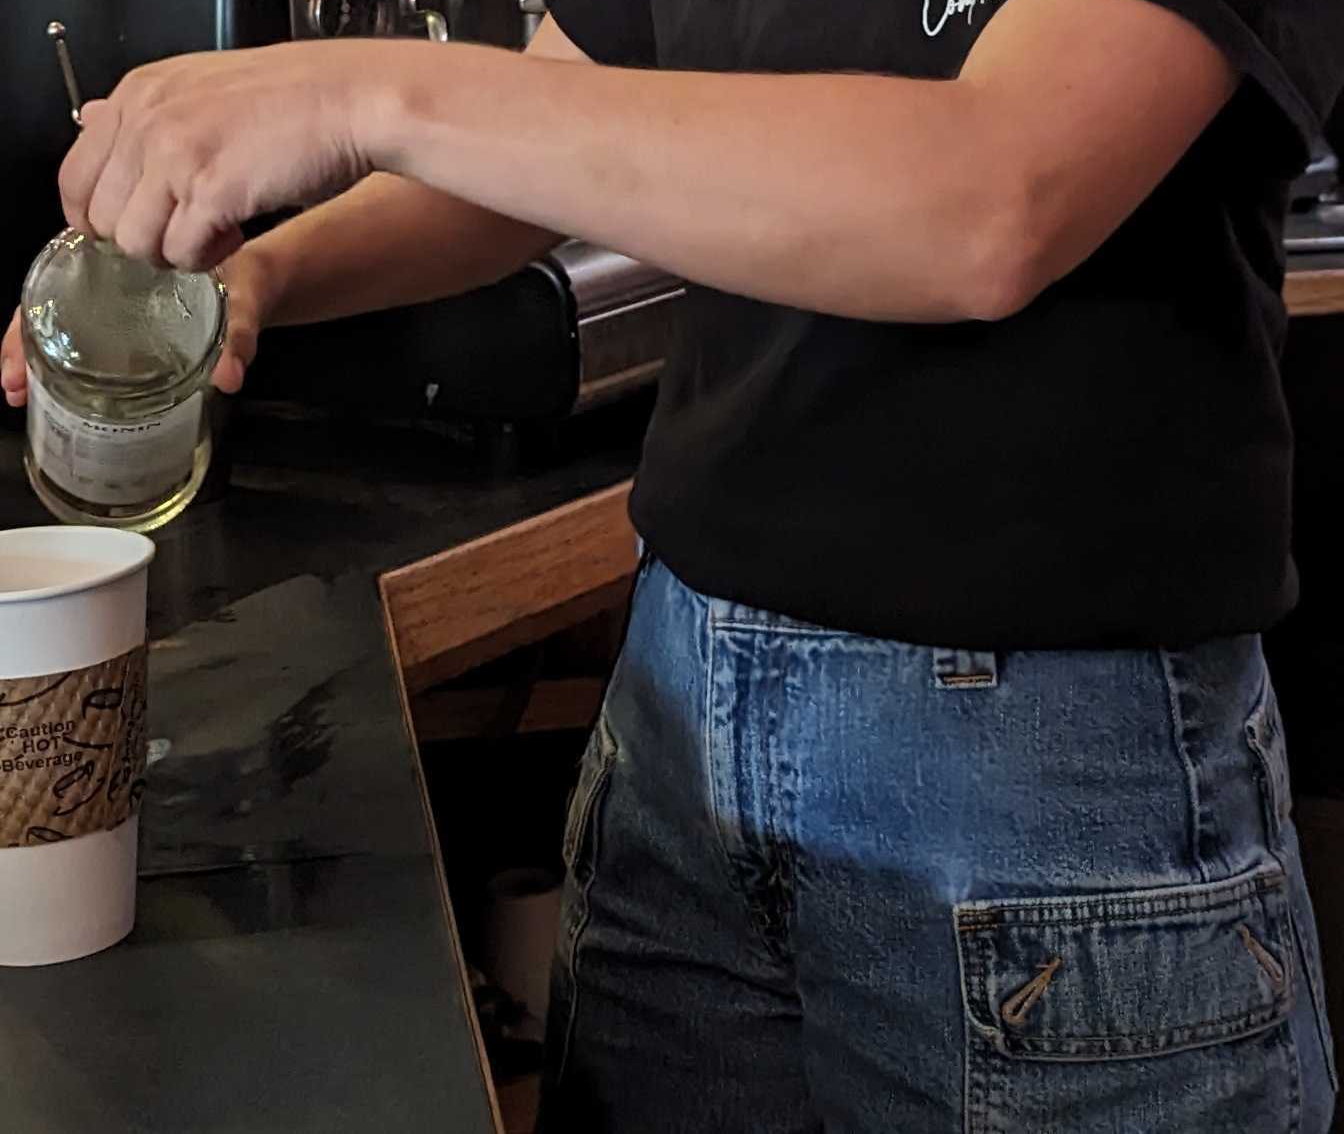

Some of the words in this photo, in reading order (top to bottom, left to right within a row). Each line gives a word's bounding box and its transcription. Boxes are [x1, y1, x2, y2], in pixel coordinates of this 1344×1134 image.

[5, 719, 76, 739] Caution
[23, 735, 62, 754] HOT
[1, 752, 84, 773] Beverage
